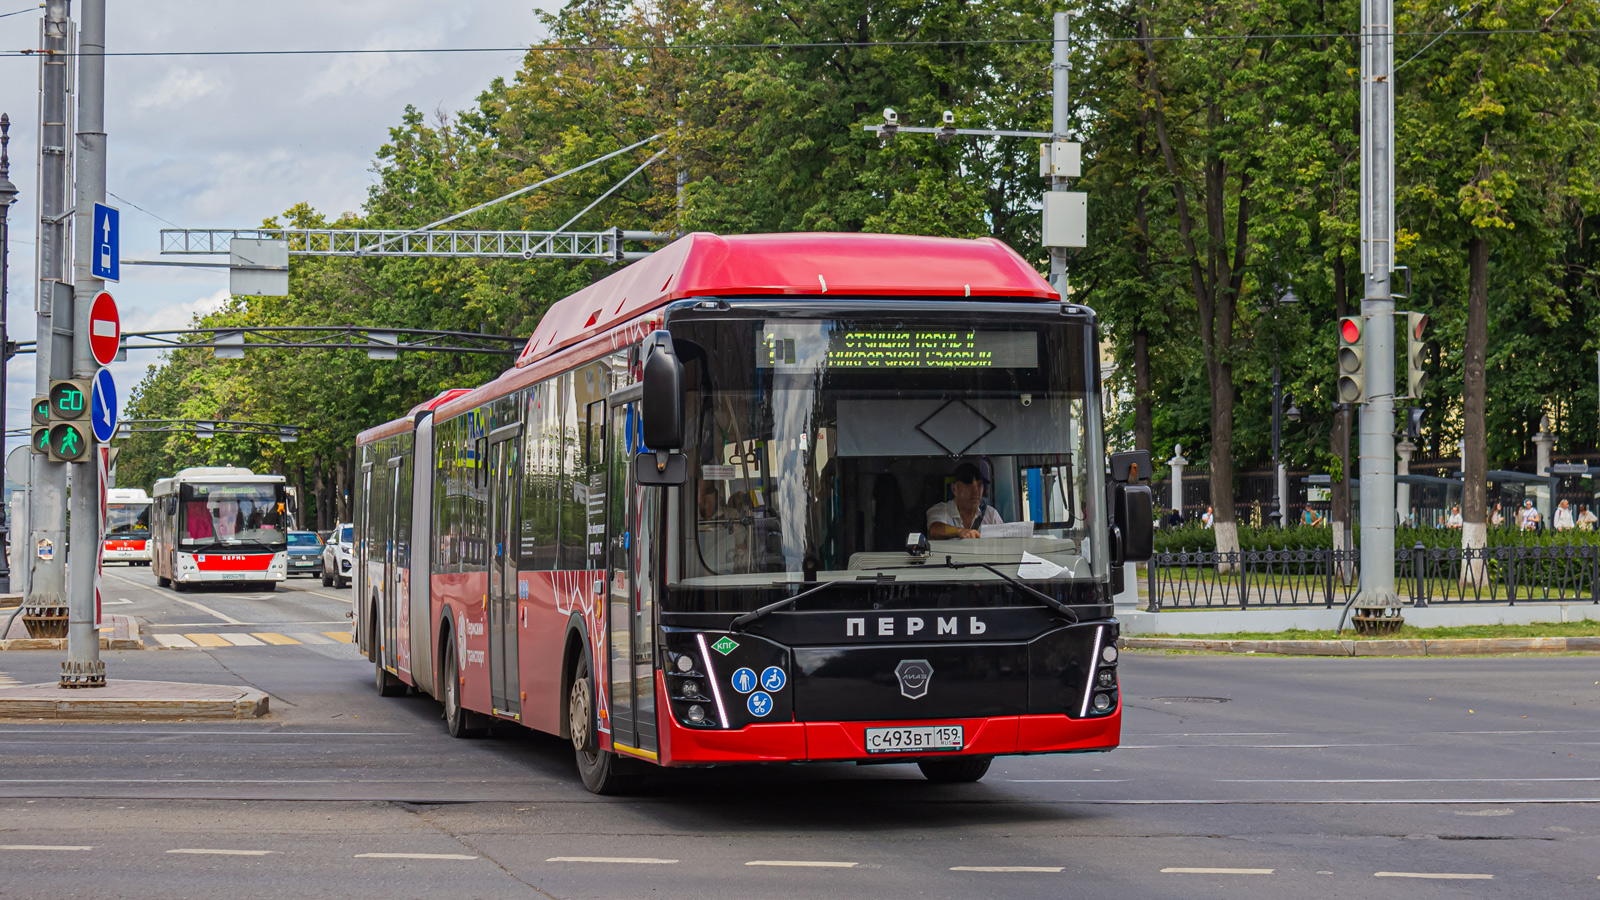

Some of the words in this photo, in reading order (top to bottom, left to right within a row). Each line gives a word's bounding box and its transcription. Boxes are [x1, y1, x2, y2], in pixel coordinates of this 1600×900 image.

[60, 389, 83, 410] 20
[466, 617, 484, 640] Пермский
[846, 616, 987, 637] ПЕРМЬ
[717, 641, 733, 650] КПГ
[467, 649, 485, 668] транспорт
[872, 730, 932, 747] С493ВТ
[936, 728, 959, 741] 159
